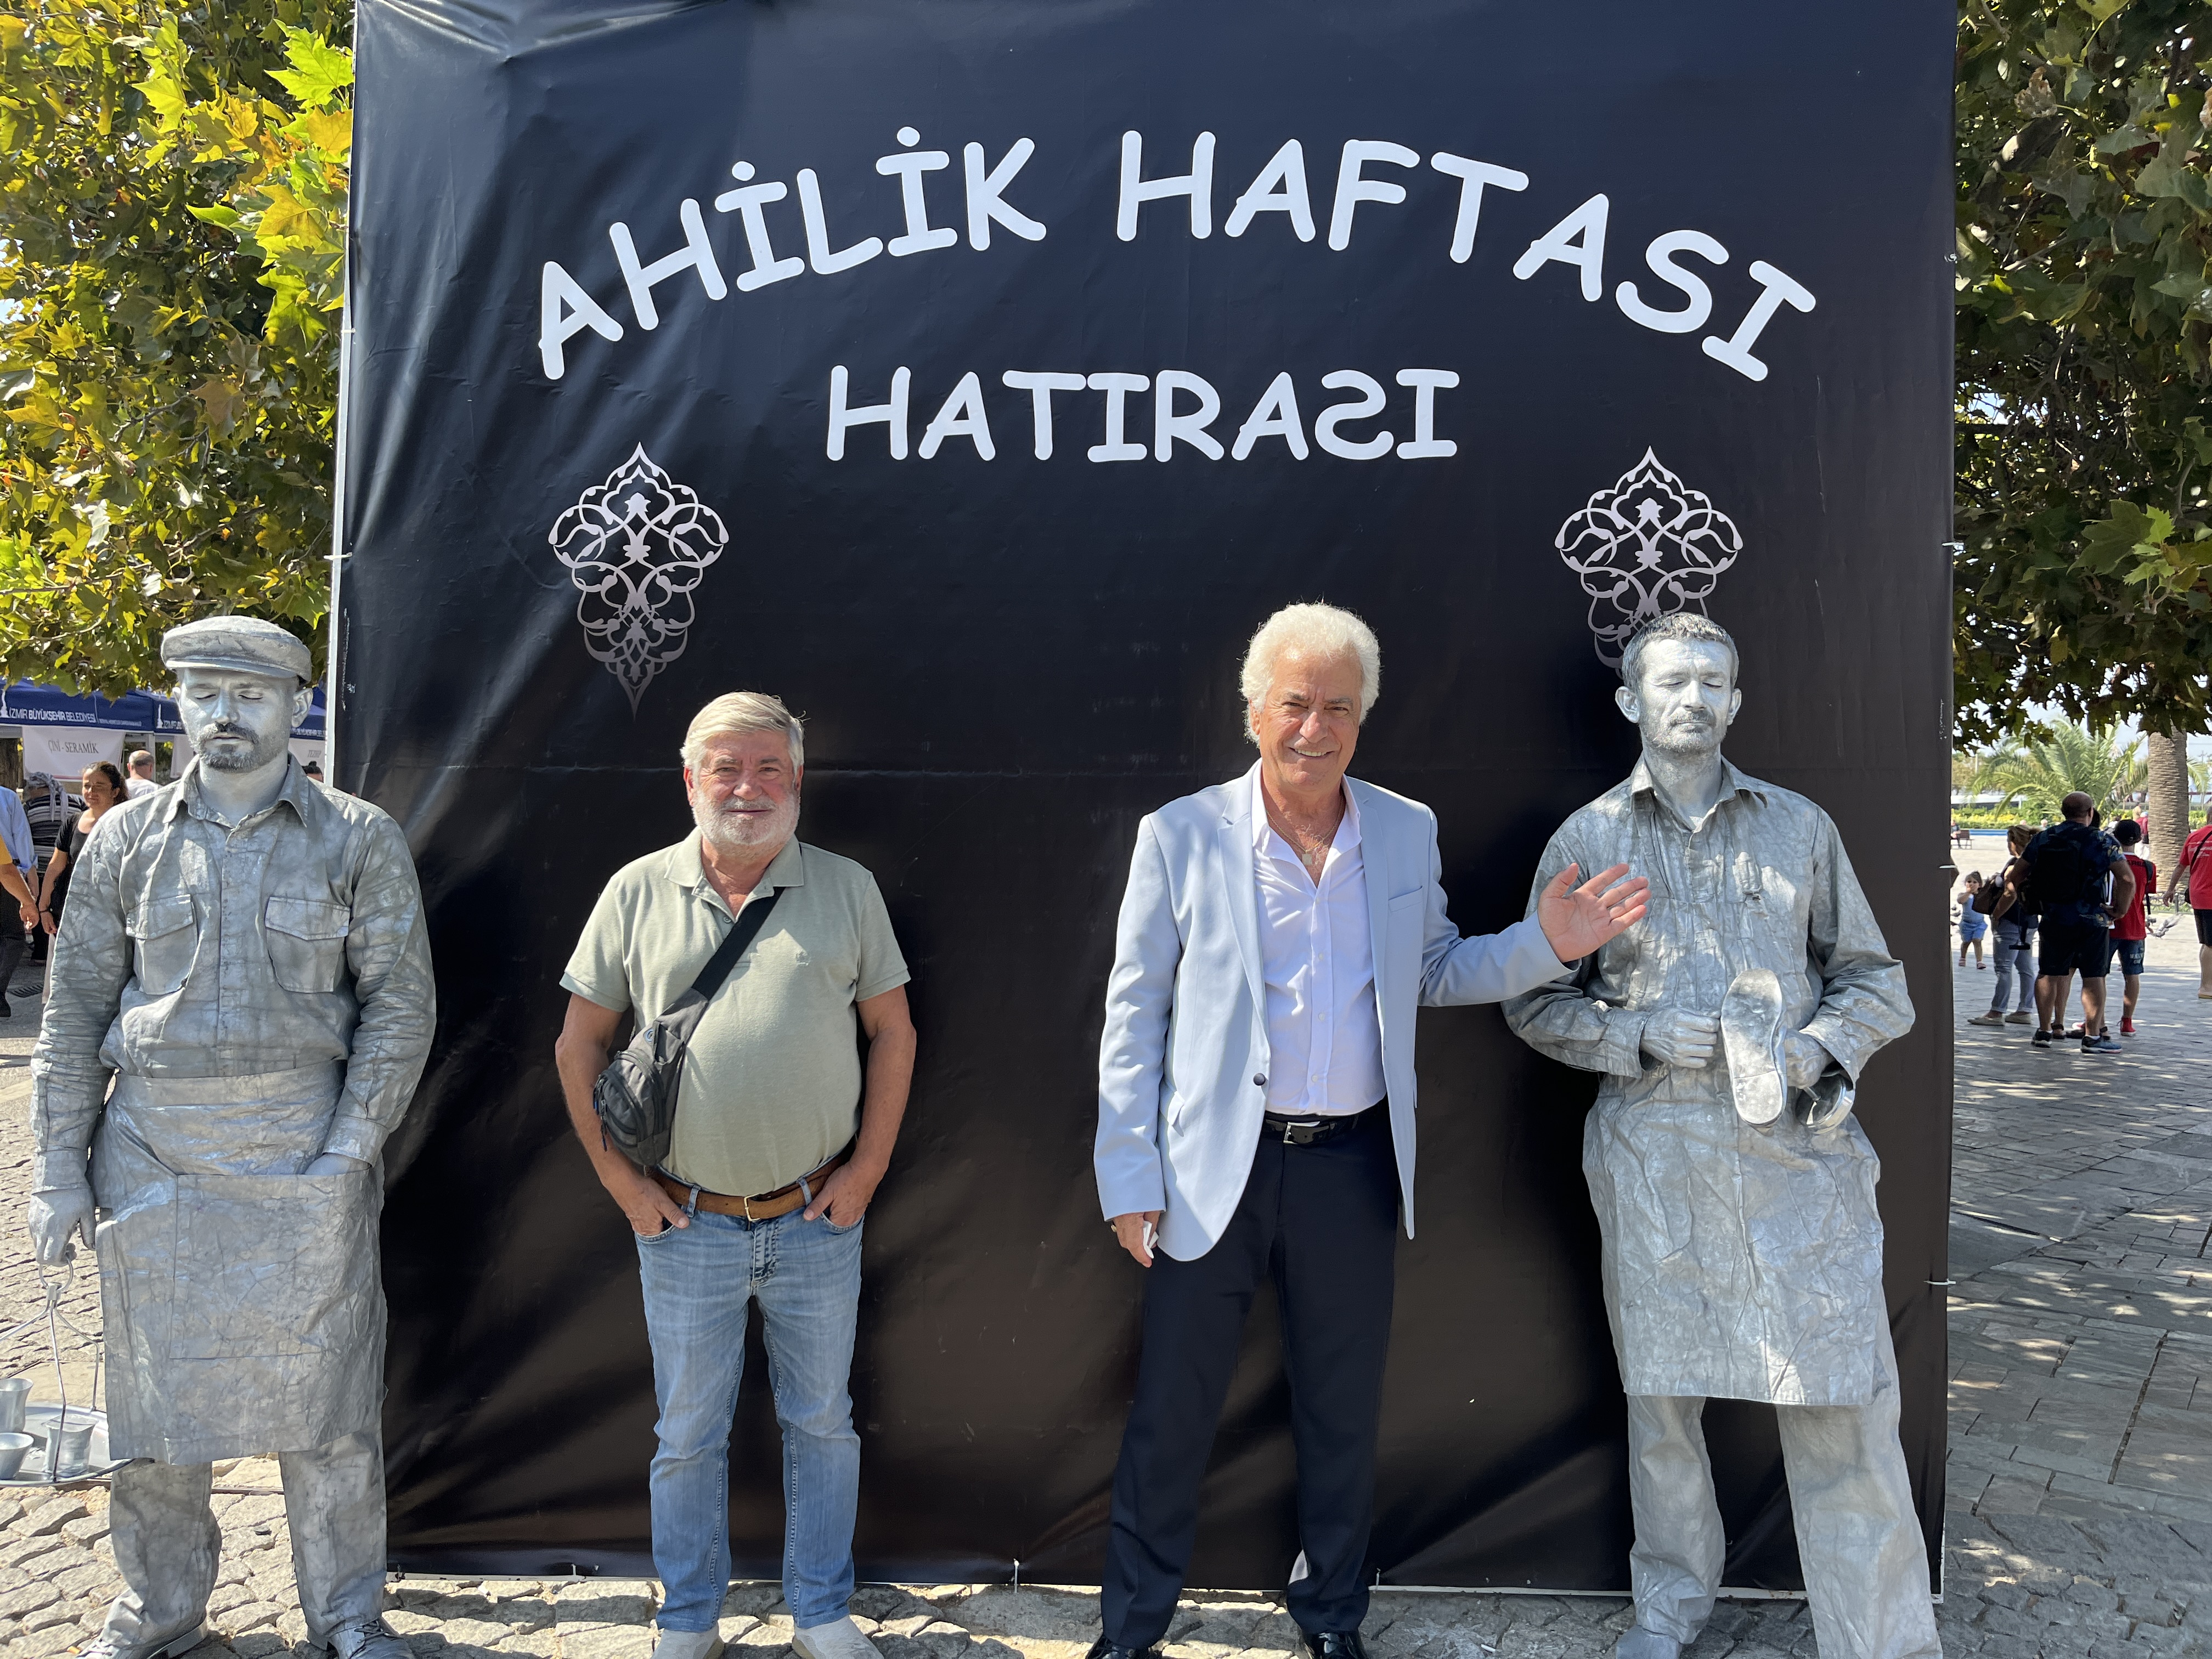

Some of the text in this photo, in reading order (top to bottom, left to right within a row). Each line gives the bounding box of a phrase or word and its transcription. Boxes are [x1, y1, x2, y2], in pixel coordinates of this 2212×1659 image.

[538, 127, 1816, 381] AHİLİK HAFTASI
[827, 365, 1459, 462] HATIRASI
[9, 707, 27, 719] İZMİR
[65, 741, 99, 754] SERAMİK
